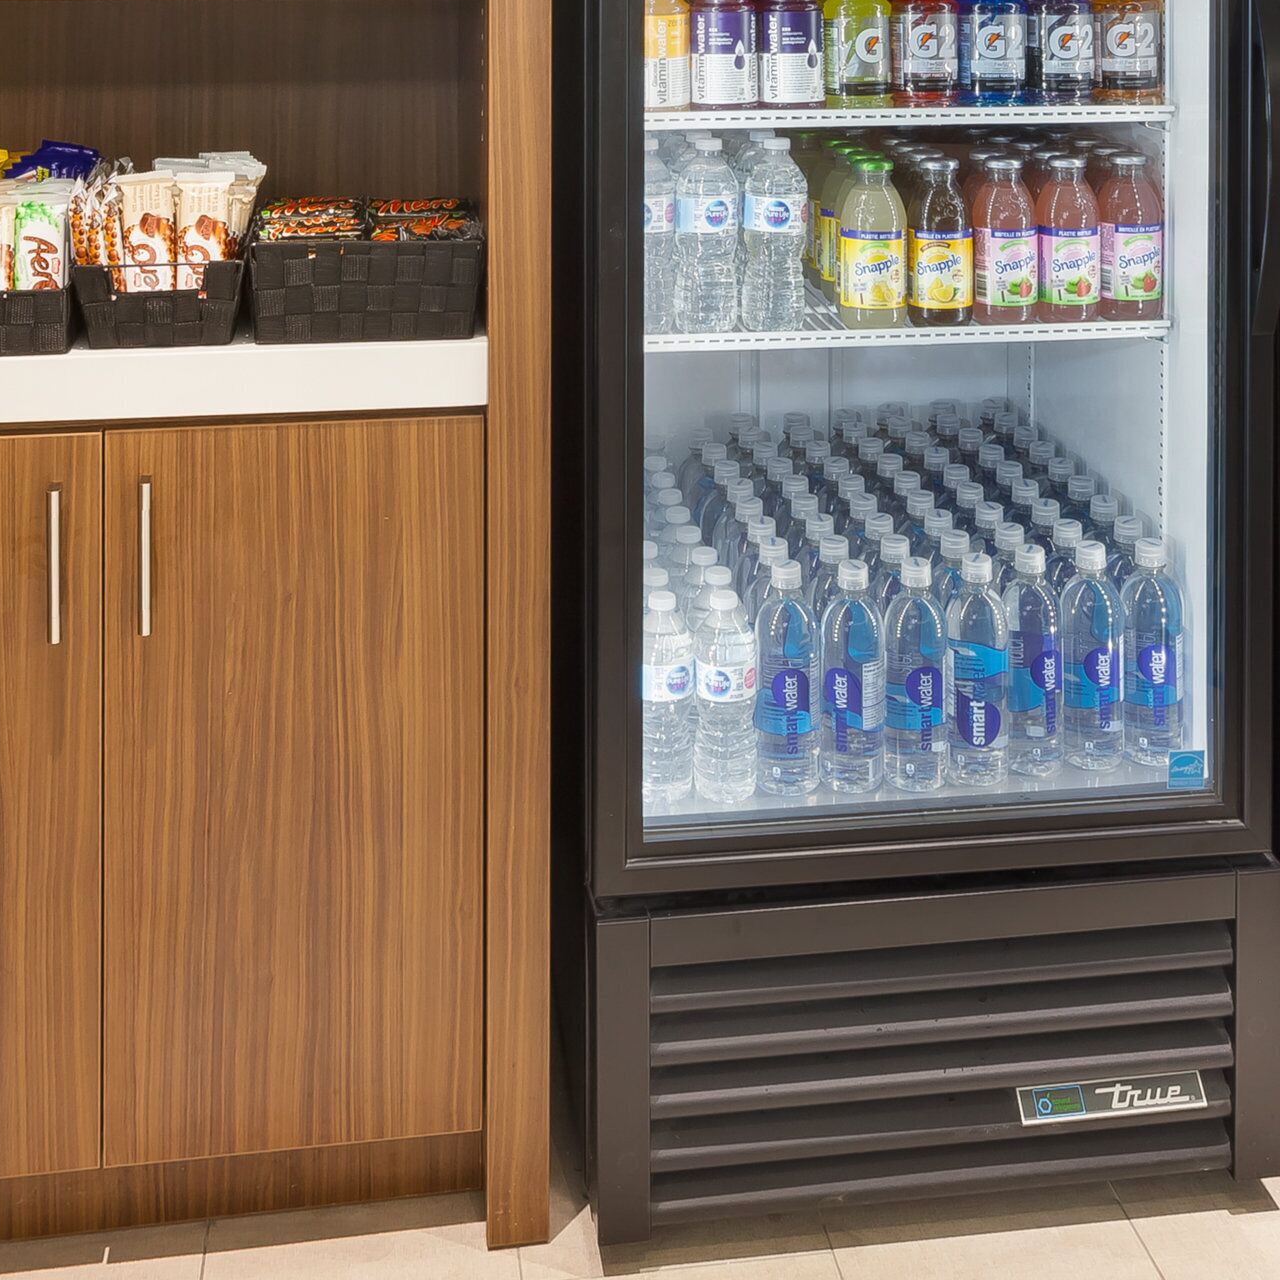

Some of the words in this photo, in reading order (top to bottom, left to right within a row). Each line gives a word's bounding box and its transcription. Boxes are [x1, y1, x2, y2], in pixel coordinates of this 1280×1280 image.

[855, 255, 899, 277] Snapple
[917, 254, 962, 276] Snapple
[995, 250, 1036, 274] Snapple
[1052, 250, 1096, 273] Snapple
[1119, 247, 1161, 269] Snapple
[1045, 655, 1057, 692] water
[1097, 652, 1110, 686] water
[1152, 649, 1165, 685] water
[786, 674, 799, 710] water
[833, 672, 848, 709] water
[919, 671, 933, 708] water
[972, 700, 986, 747] smart
[1095, 1082, 1190, 1109] true
